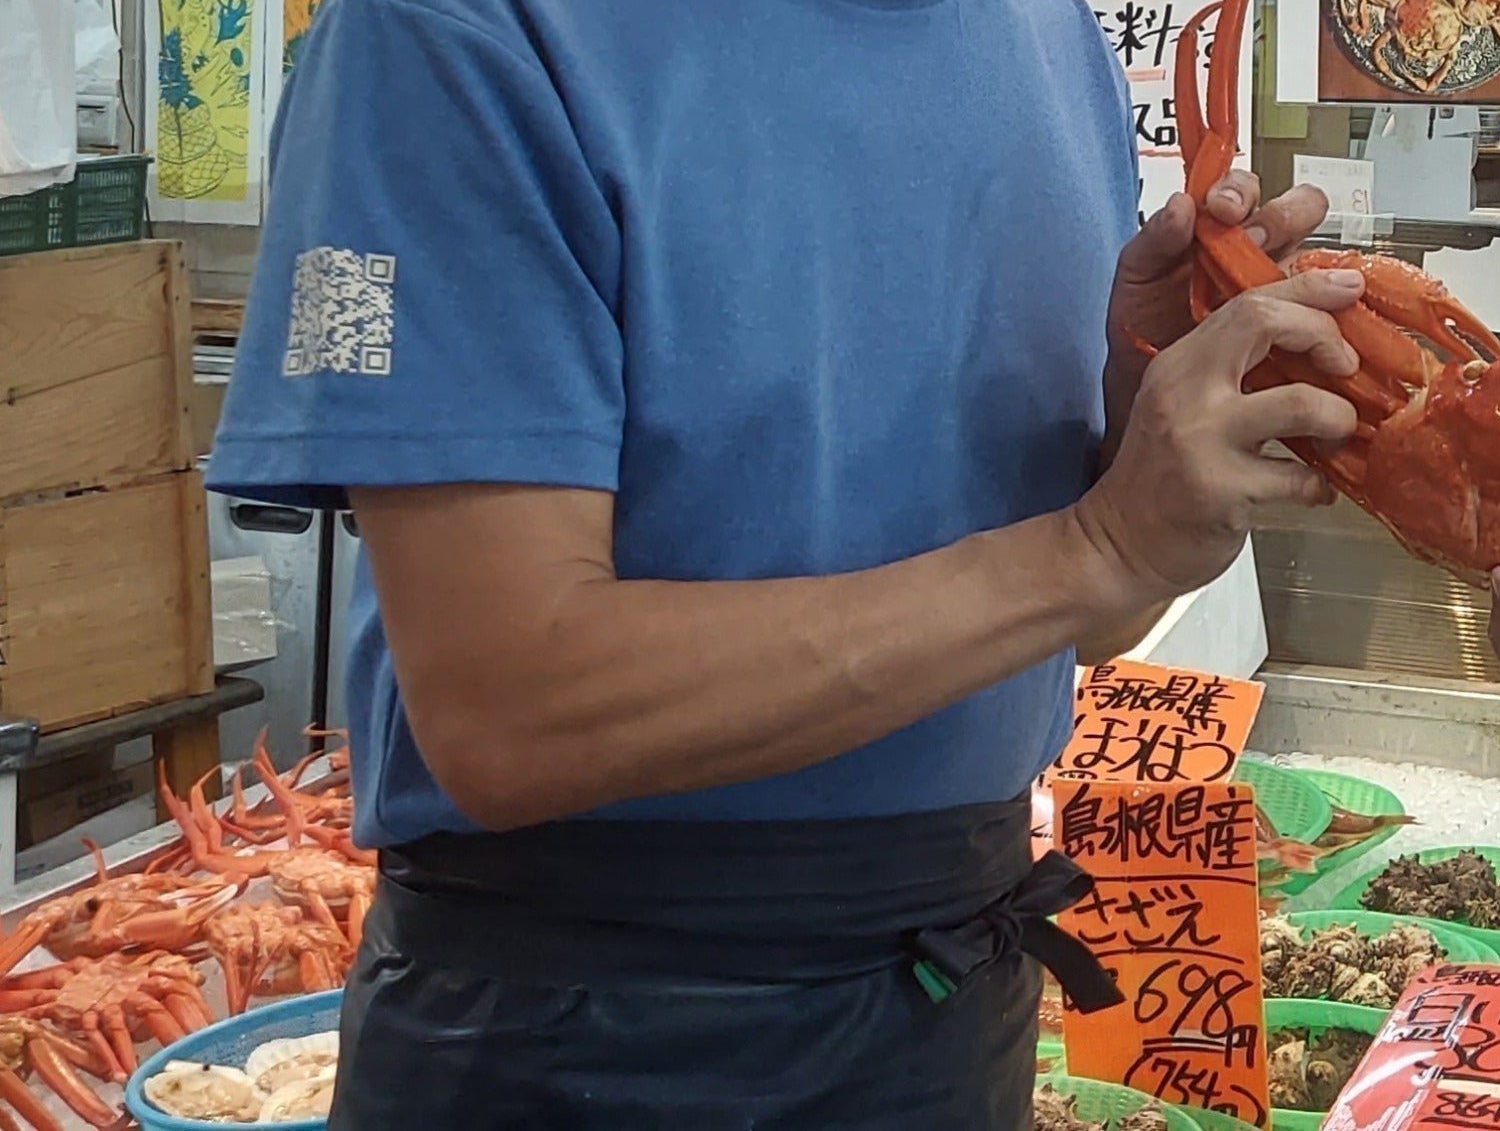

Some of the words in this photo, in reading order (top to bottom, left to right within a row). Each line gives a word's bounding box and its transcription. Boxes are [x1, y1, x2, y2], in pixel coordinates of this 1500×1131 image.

[1061, 784, 1256, 870] 島根県産
[1073, 884, 1221, 949] さざえ
[1133, 959, 1259, 1069] 698円
